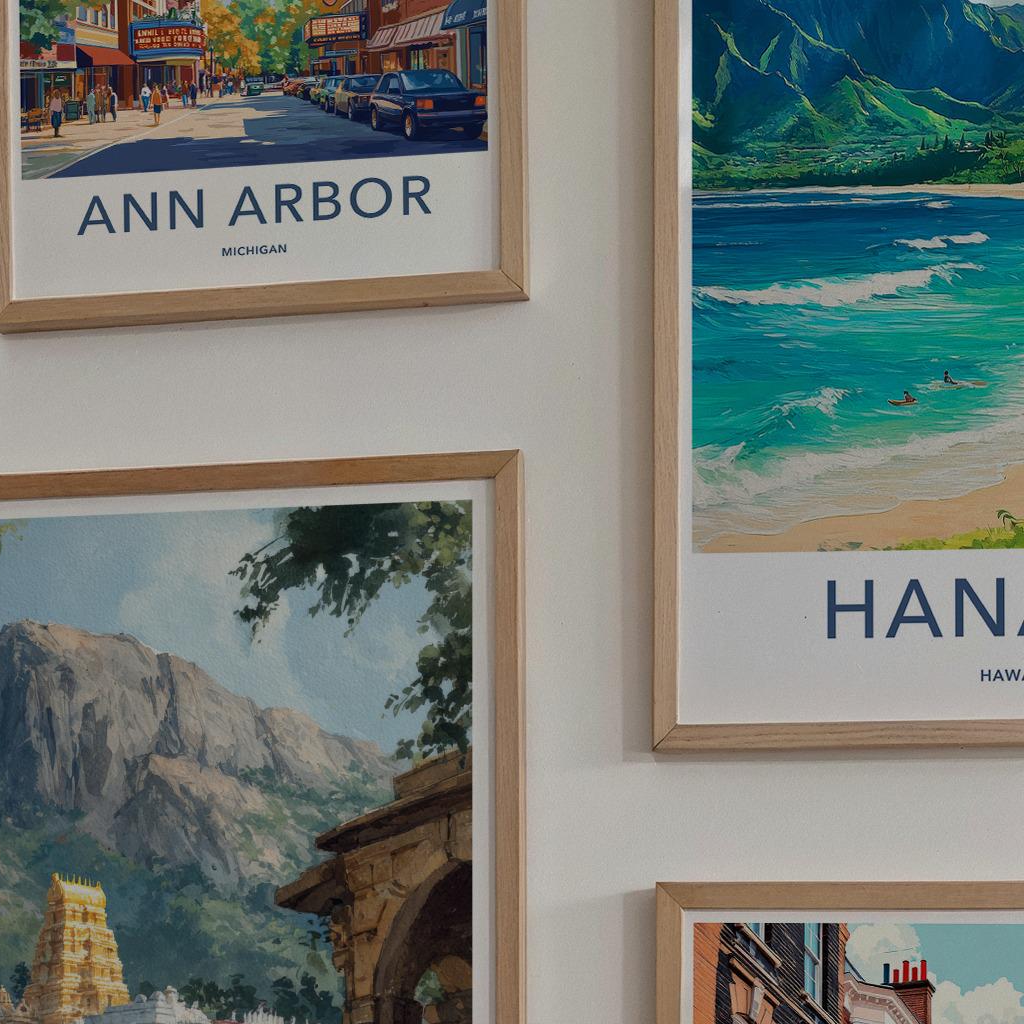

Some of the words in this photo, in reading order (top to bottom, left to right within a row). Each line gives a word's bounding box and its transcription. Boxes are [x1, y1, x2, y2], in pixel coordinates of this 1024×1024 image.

[77, 189, 204, 235] ANN
[228, 175, 432, 226] ARBOR
[221, 243, 288, 257] MICHIGAN
[826, 577, 1024, 639] HAN
[980, 668, 1024, 682] HAW
